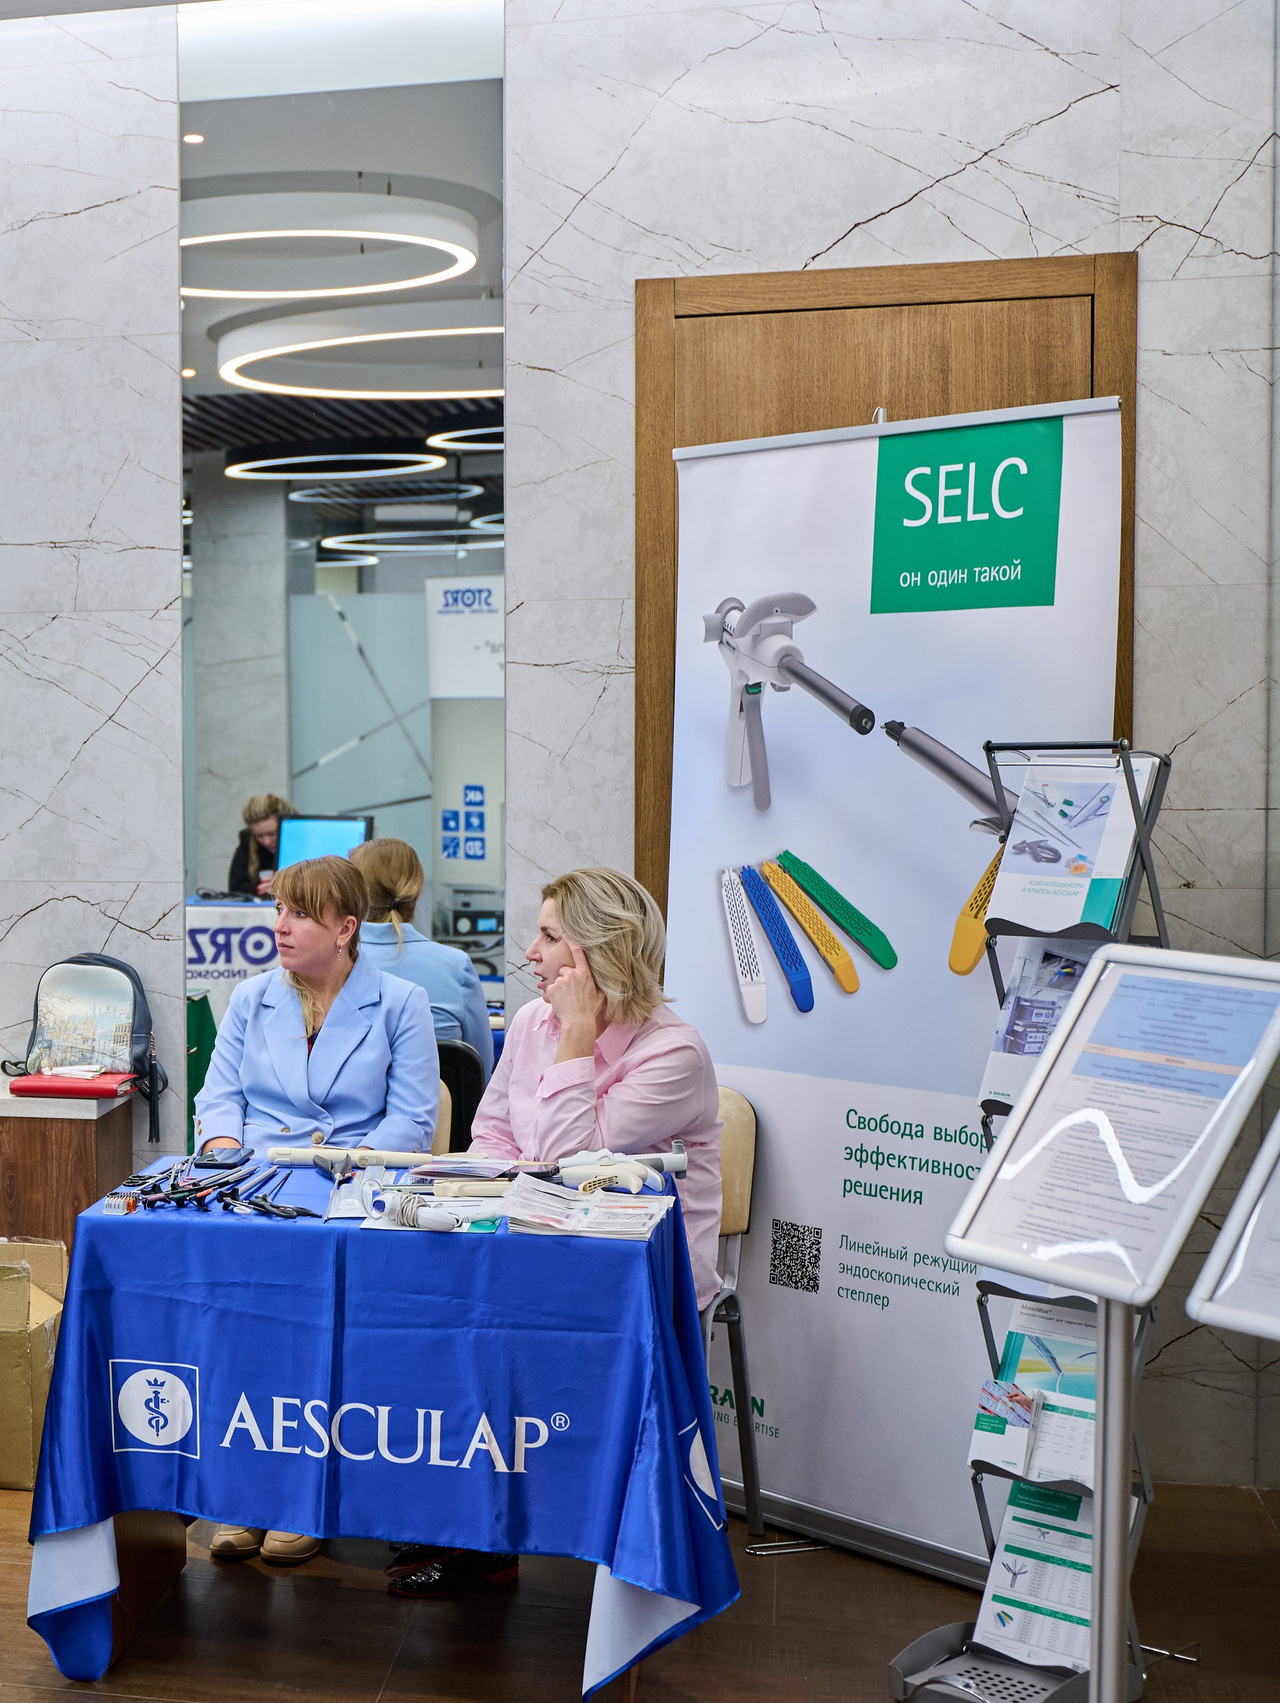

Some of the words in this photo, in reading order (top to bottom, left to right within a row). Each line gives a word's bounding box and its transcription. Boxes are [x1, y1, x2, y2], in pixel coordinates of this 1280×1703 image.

[903, 457, 1028, 527] SELC
[899, 571, 920, 587] он
[928, 568, 967, 588] один
[973, 559, 1021, 583] такой
[846, 1108, 924, 1139] Свобода
[933, 1125, 997, 1154] выбор
[843, 1178, 923, 1206] решения
[839, 1234, 908, 1262] Линейный
[913, 1252, 977, 1275] режущий
[838, 1262, 960, 1297] эндоскопический
[837, 1285, 890, 1311] степлер
[709, 1384, 765, 1418] RAN
[713, 1410, 730, 1424] ING
[733, 1417, 780, 1439] ERTISE
